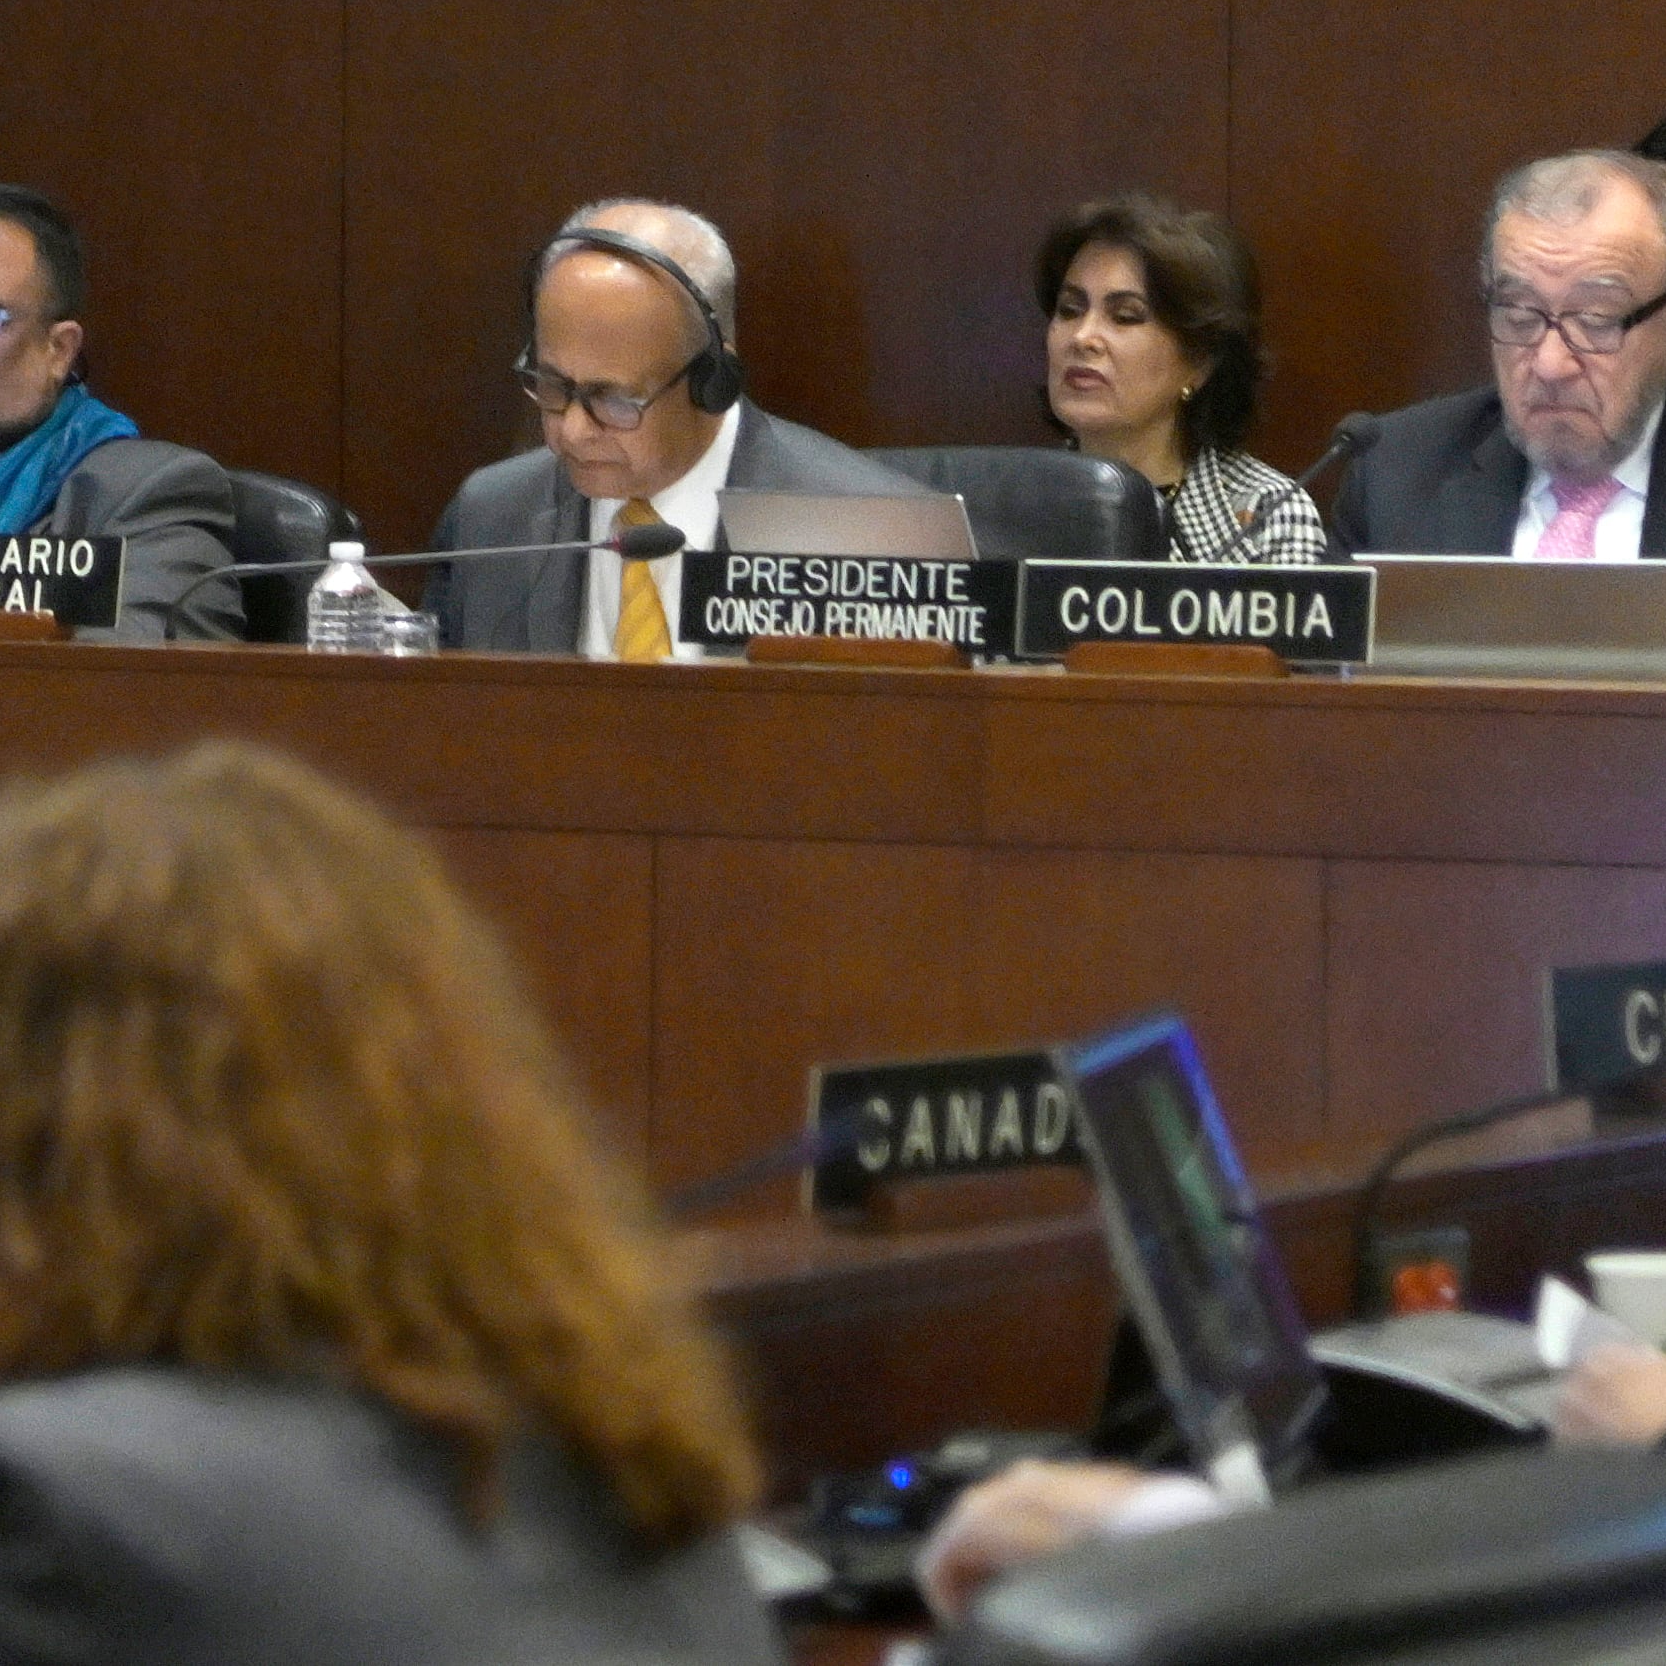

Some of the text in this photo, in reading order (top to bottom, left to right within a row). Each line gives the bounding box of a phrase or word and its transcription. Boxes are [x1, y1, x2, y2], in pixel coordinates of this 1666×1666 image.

[726, 555, 970, 602] PRESIDENTE
[705, 597, 986, 644] CONSEJO PERMANENTE
[1060, 586, 1334, 639] COLOMBIA
[857, 1083, 1072, 1171] CANAD
